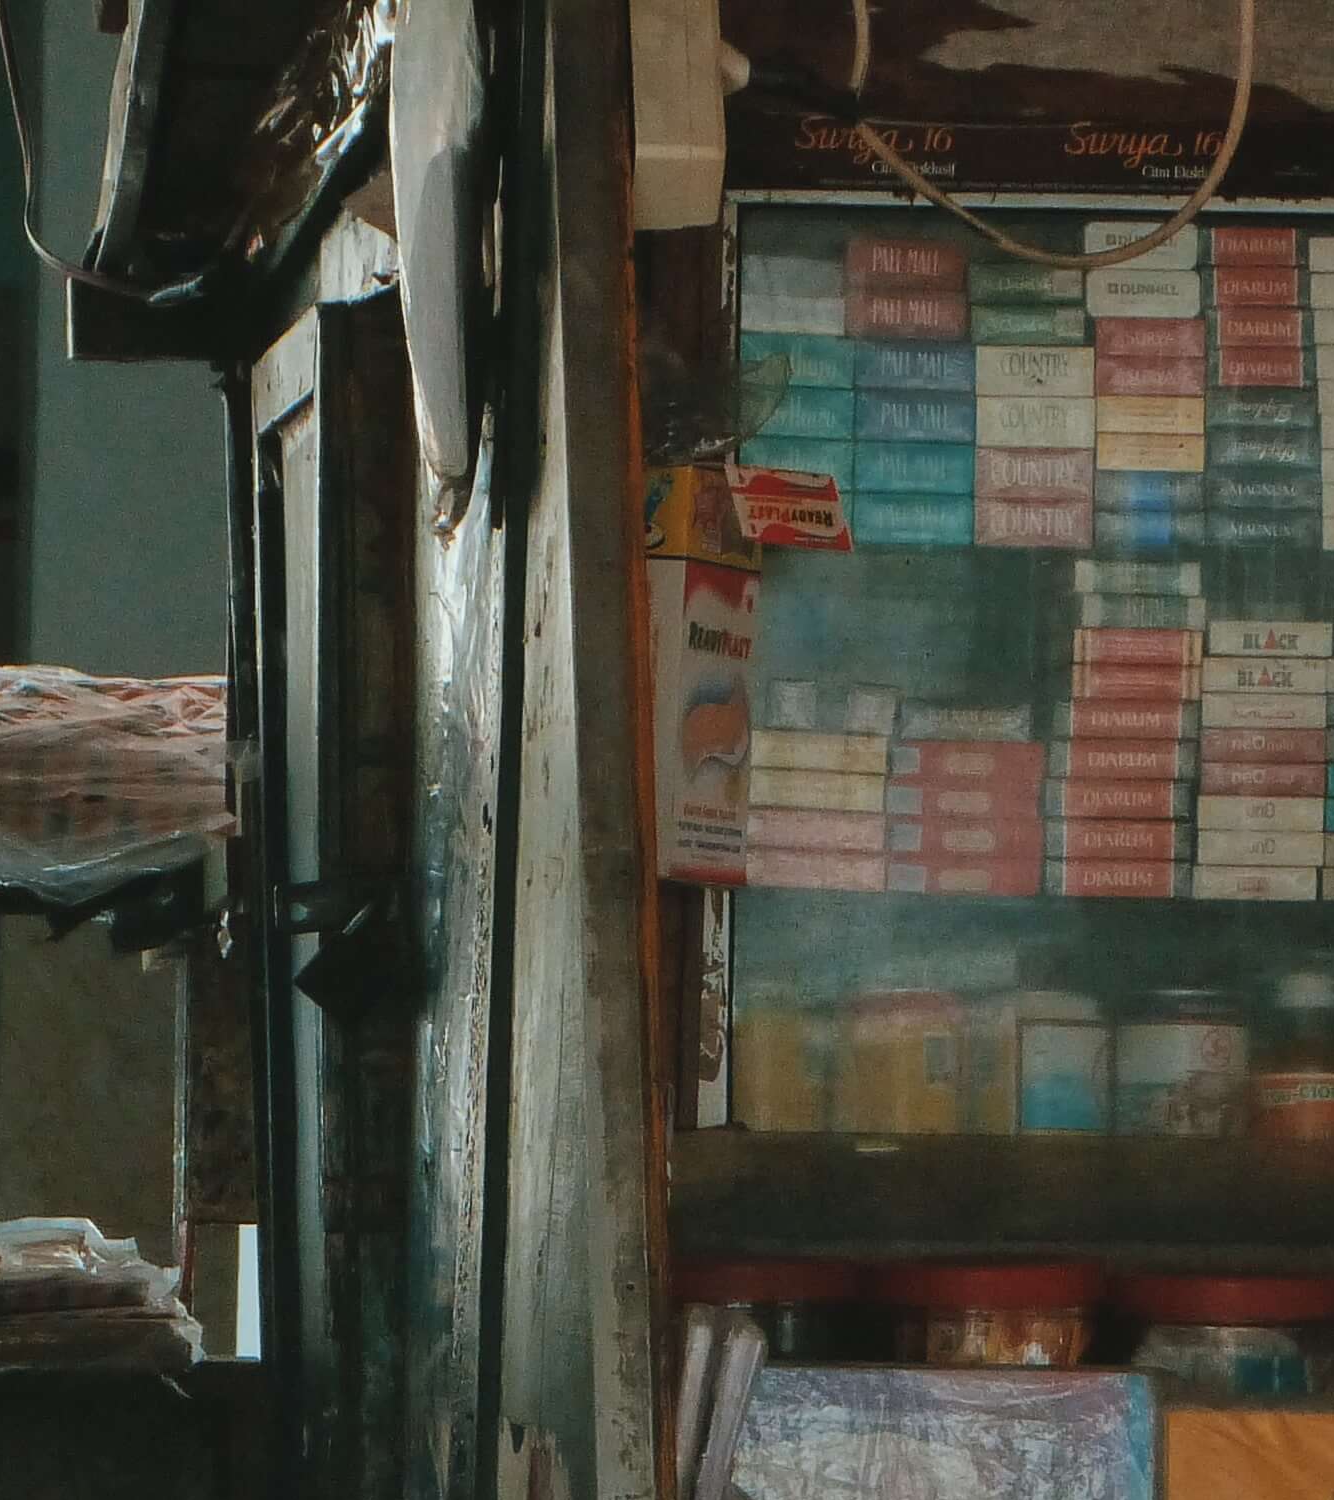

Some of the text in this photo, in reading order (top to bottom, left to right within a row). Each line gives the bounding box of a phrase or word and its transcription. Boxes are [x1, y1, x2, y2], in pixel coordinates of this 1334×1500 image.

[923, 128, 953, 151] 16
[1193, 131, 1224, 156] 16
[1000, 352, 1069, 377] COUNTRY
[999, 403, 1067, 428] COUNTRY
[992, 455, 1075, 487] COUNTRY
[992, 510, 1074, 538] COUNTRY
